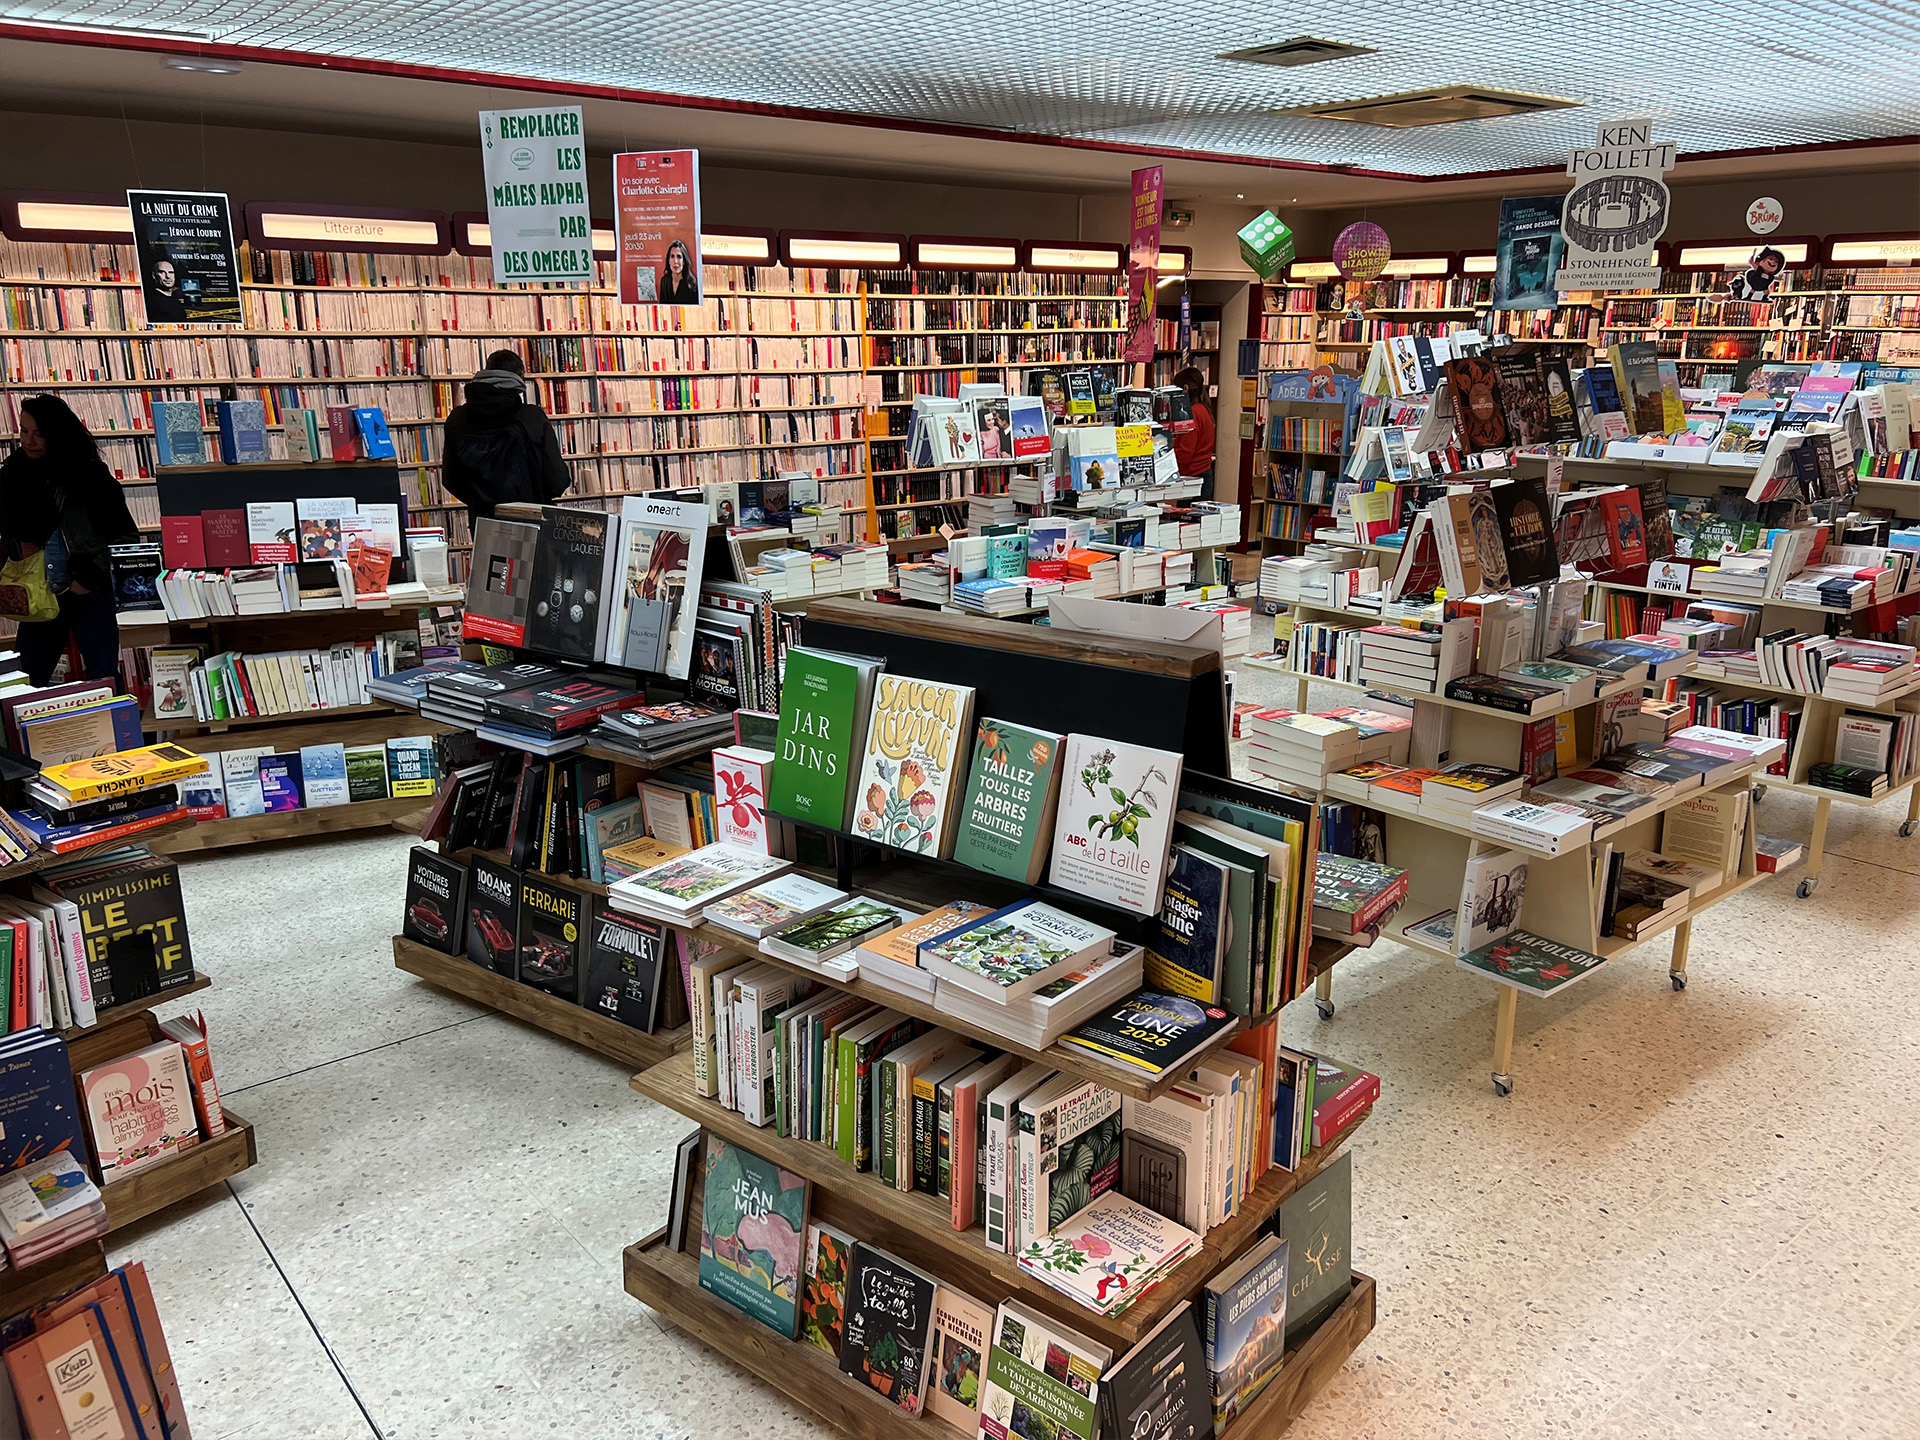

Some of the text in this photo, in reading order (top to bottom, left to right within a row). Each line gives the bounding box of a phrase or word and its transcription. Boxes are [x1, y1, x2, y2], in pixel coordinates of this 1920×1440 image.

[500, 113, 579, 139] REMPLACER
[1601, 126, 1648, 147] KEN
[557, 149, 581, 170] LES
[1571, 145, 1673, 173] FOLLETT
[622, 183, 688, 195] Charlotte Casiraghi
[632, 177, 643, 185] soir
[1143, 180, 1149, 190] LE
[493, 181, 584, 207] MÂLES ALPHA
[1135, 190, 1158, 207] BONHEUR
[141, 203, 219, 217] LA NUIT DU CRIME
[1143, 213, 1158, 227] LIVRES
[1145, 203, 1155, 215] DANS
[197, 228, 222, 238] LOUBRY
[559, 217, 587, 238] PAR
[624, 233, 638, 242] jeudi
[648, 232, 662, 240] avril
[1515, 223, 1533, 231] BANDE
[625, 242, 644, 250] 20h30
[1277, 240, 1293, 255] LIVRE
[1348, 249, 1377, 259] SHOW
[504, 251, 590, 273] DES OMEGA 3
[1570, 258, 1650, 270] STONEHENGE
[1588, 271, 1604, 279] BÂTI
[1624, 271, 1657, 279] LÉGENDE
[1864, 370, 1899, 379] DETROIT
[646, 503, 682, 517] oneart
[1509, 511, 1540, 528] HISTOIRE
[1514, 521, 1544, 537] L'EUROPE
[571, 543, 580, 552] LA
[141, 560, 157, 568] Océan
[1654, 581, 1681, 591] TINTIN
[513, 664, 553, 678] 911
[552, 683, 620, 701] 911
[696, 679, 737, 695] MOTOGP
[1614, 691, 1633, 700] HOMO
[877, 677, 957, 729] SAVOIR
[1606, 698, 1640, 709] CRIMINALIS
[791, 708, 831, 741] JAR
[226, 754, 258, 764] Leçons
[397, 750, 420, 762] QUAND
[398, 762, 421, 772] L'OCÉAN
[782, 738, 837, 777] DINS
[983, 757, 1035, 787] TAILLEZ
[96, 776, 145, 793] PLANCHA
[979, 774, 1031, 803] TOUS LES
[795, 793, 813, 808] BOSC
[974, 791, 1027, 822] ARBRES
[1502, 805, 1534, 818] NOUS
[1681, 799, 1719, 812] Sapiens
[76, 822, 147, 846] POTATO BOOK POPPY
[725, 824, 757, 840] LE POMMIER
[972, 809, 1023, 838] FRUITIERS
[1063, 832, 1087, 848] l'ABC
[1082, 842, 1150, 875] de la taille
[413, 874, 450, 899] ITALIENNES
[417, 864, 449, 887] VOITURES
[476, 867, 512, 897] 100 ANS
[79, 873, 172, 907] SIMPLISSIME
[477, 883, 512, 907] D'AUTOMOBILES
[522, 886, 572, 919] FERRARI
[1186, 897, 1199, 907] son
[81, 901, 128, 934] LE
[1022, 912, 1090, 942] BOTANIQUE
[1030, 910, 1095, 939] HISTOIRE DE LA
[1510, 932, 1600, 968] NAPOLÉON
[1112, 1009, 1188, 1038] LUNE
[1121, 1000, 1201, 1027] JARDINEZ
[1118, 1025, 1171, 1047] 2026
[105, 1077, 175, 1116] mois
[1059, 1091, 1092, 1112] LE TRAITÉ
[1060, 1087, 1116, 1125] DES PLANTES
[110, 1104, 179, 1136] habitudes
[113, 1114, 180, 1145] alimentaires
[884, 1111, 894, 1144] JARDIN
[1059, 1100, 1113, 1140] D'INTÉRIEUR
[915, 1100, 924, 1172] GUIDE DELACHAUX
[924, 1131, 932, 1175] DES FLEURS
[732, 1178, 773, 1210] JEAN
[734, 1195, 768, 1225] MUS
[1087, 1210, 1165, 1253] les techniques
[1099, 1208, 1164, 1244] J'apprends
[1093, 1224, 1142, 1251] de taille
[871, 1275, 910, 1299] Le guide
[1237, 1258, 1277, 1298] NICOLAS VANIER
[1229, 1265, 1285, 1322] LES PIEDS SUR TERRE
[869, 1294, 910, 1320] taille
[946, 1321, 983, 1348] NICHEURS
[971, 1326, 983, 1339] DES
[60, 1357, 88, 1379] Kiub
[904, 1355, 914, 1368] 80
[996, 1361, 1086, 1421] LA TAILLE RAISONNÉE
[1008, 1359, 1076, 1404] ENCYCLOPÉDIE PRIEUR
[1009, 1380, 1069, 1422] DES ARBUSTES
